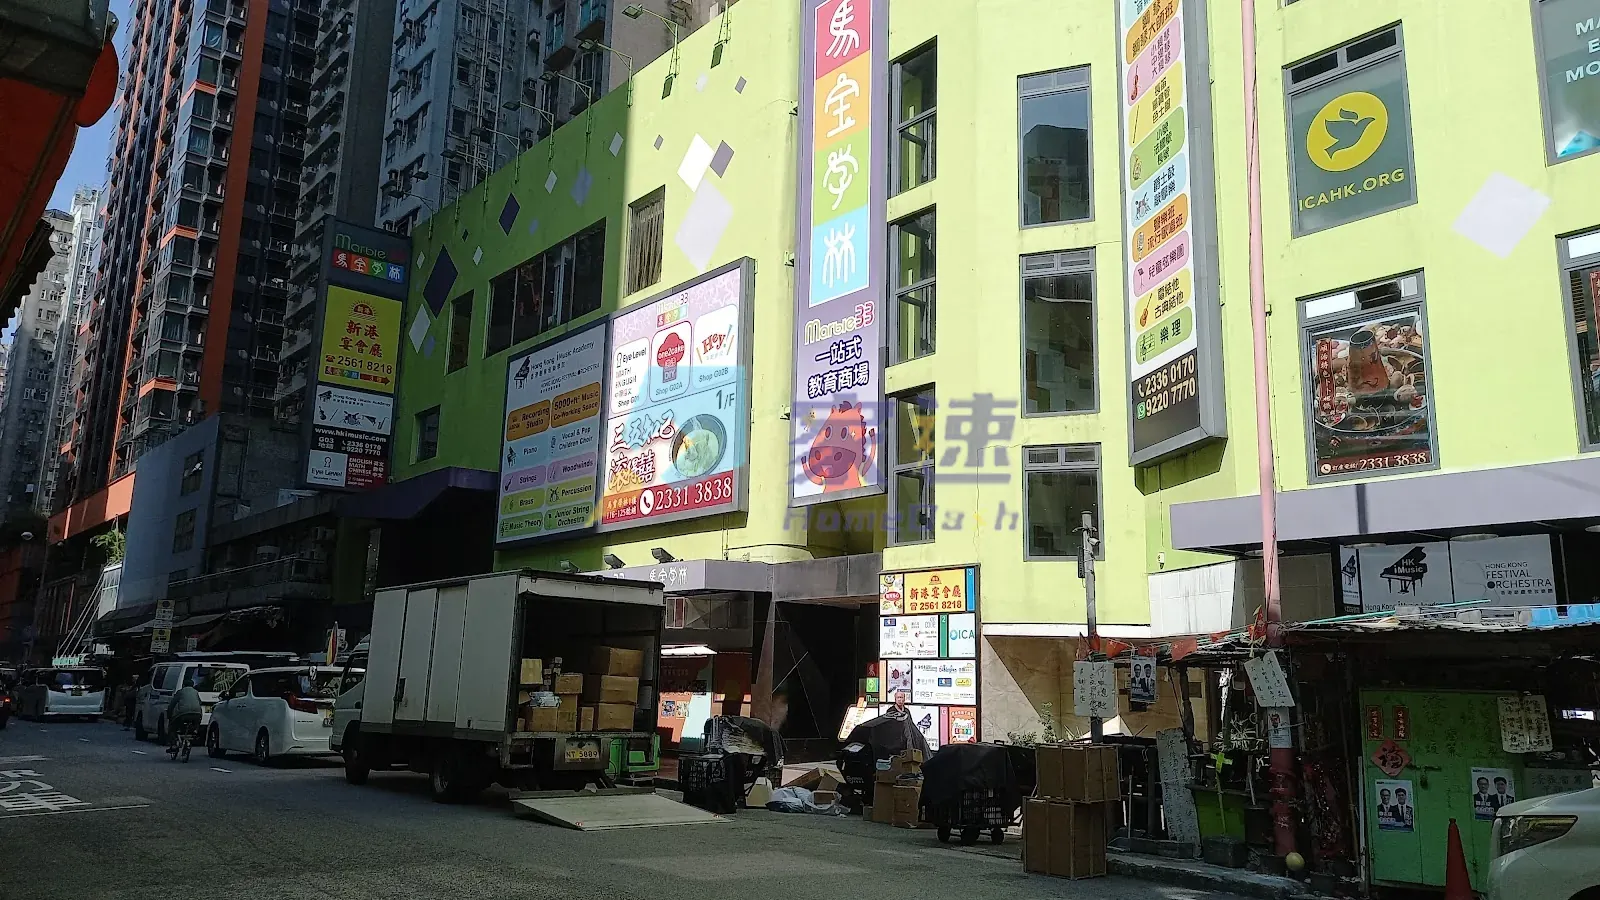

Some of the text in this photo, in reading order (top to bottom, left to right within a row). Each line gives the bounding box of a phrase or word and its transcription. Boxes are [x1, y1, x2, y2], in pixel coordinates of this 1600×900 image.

[1298, 168, 1406, 212] ICAHK.ORG
[345, 320, 379, 340] 新港
[657, 344, 685, 360] one2cake
[815, 335, 863, 366] 一站式
[338, 355, 393, 375] 2561 8218
[808, 362, 870, 400] 教育商場
[1145, 354, 1195, 396] 2336 0170
[1146, 377, 1196, 417] 9220 7770
[521, 407, 550, 421] Recording
[526, 418, 544, 430] Studio
[314, 427, 387, 443] www.hkimusic.com
[558, 435, 594, 451] Children Choir
[523, 447, 538, 456] Piano
[562, 459, 594, 474] Woodwinds
[1359, 456, 1390, 471] 2331
[1393, 452, 1427, 466] 3838
[519, 474, 537, 485] Strings
[561, 484, 592, 497] Percussion
[655, 477, 733, 511] 2331 3838
[519, 498, 534, 507] Brass
[572, 504, 590, 516] String
[509, 518, 543, 531] Music Theory
[557, 516, 585, 527] Orchestra
[1401, 558, 1415, 566] HK
[1394, 565, 1424, 574] iMusic
[1486, 570, 1532, 579] FESTIVAL
[910, 584, 962, 600] 新港宴會廳
[919, 600, 962, 611] 2561 8218
[1364, 604, 1381, 612] Hong
